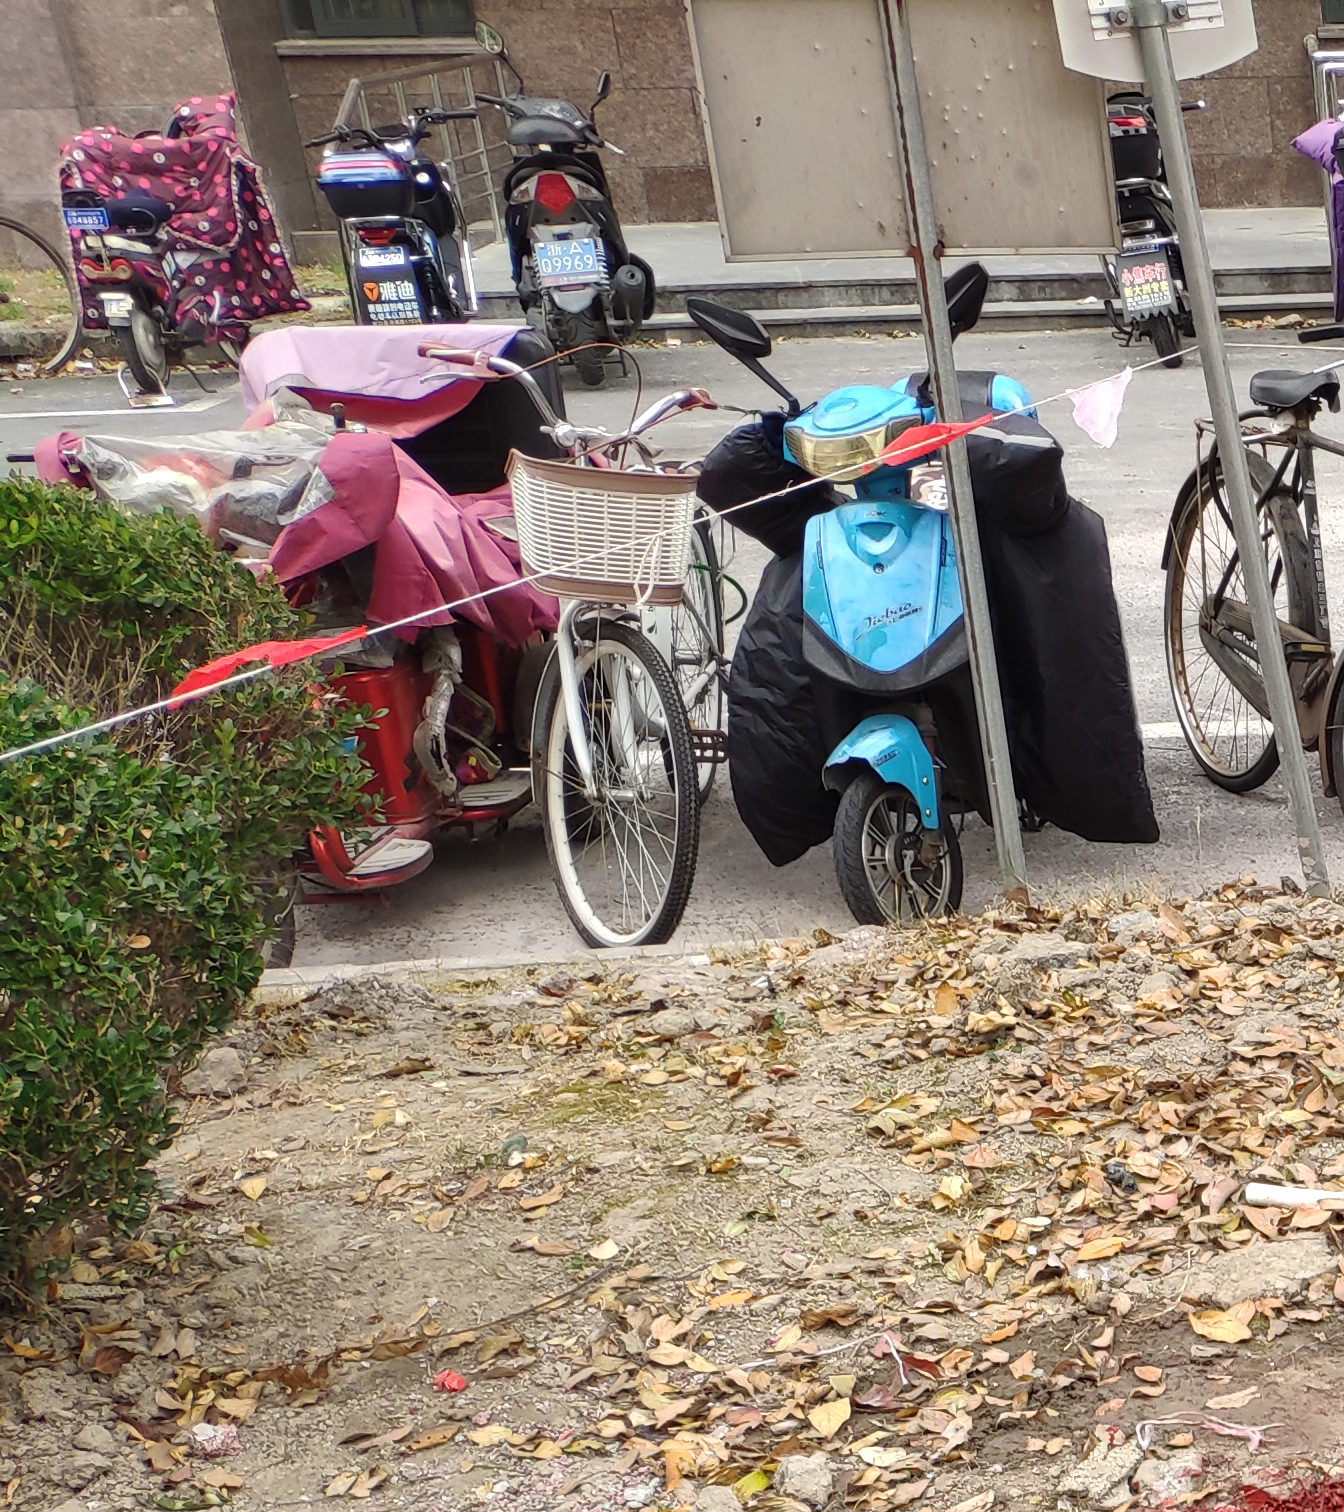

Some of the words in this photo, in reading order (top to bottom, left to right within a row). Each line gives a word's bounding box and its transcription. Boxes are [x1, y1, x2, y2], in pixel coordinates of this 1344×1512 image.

[547, 242, 583, 256] 浙·A
[542, 255, 593, 273] Q9969
[379, 280, 416, 301] 雅迪
